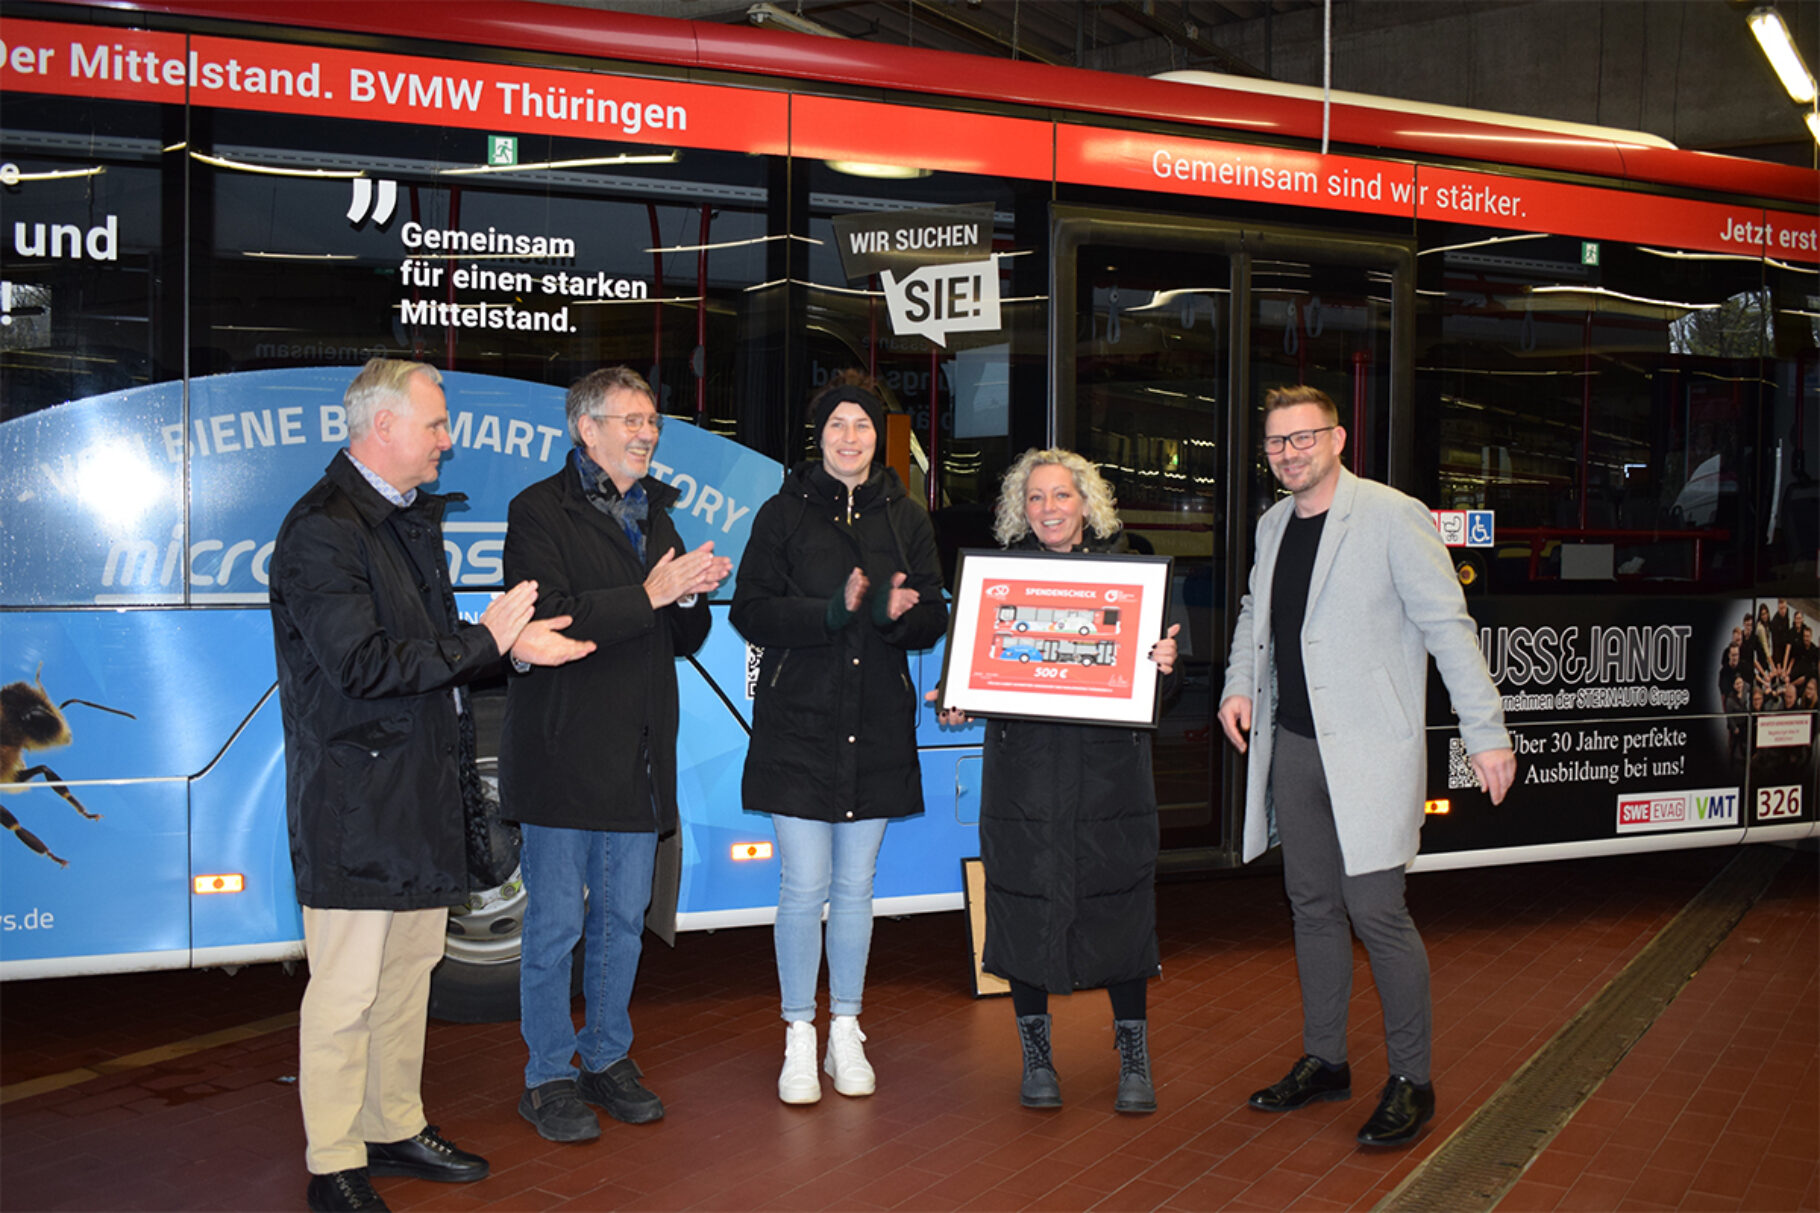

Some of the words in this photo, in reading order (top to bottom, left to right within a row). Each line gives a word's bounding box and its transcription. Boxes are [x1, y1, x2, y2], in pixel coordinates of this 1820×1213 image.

[70, 42, 333, 99] Mittelstand.
[351, 68, 484, 112] BVMW
[496, 82, 687, 134] Thüringen
[1152, 150, 1318, 193] Gemeinsam
[1327, 169, 1381, 201] sind
[1390, 178, 1428, 205] wir
[1436, 184, 1527, 217] stärker.
[15, 215, 117, 261] und
[401, 222, 575, 257] Gemeinsam
[850, 231, 890, 254] WIR
[895, 224, 978, 250] SUCHEN
[1720, 217, 1773, 246] Jetzt
[1779, 229, 1817, 251] erst
[401, 259, 443, 287] für
[452, 264, 532, 293] einen
[541, 272, 647, 299] starken
[905, 275, 981, 322] SIE!
[401, 299, 577, 332] Mittelstand.
[162, 406, 306, 464] BIENE
[1025, 587, 1096, 599] SPENDENSCHECK
[1477, 625, 1692, 686] USS&JANOT
[1034, 667, 1057, 679] 500
[1059, 668, 1068, 679] €
[1556, 688, 1577, 710] der
[1576, 686, 1648, 709] STERNAUTO
[1649, 685, 1690, 710] Gruppe
[1551, 732, 1572, 752] 30
[1576, 730, 1619, 751] Jahre
[1623, 727, 1687, 754] perfekte
[1525, 761, 1619, 784] Ausbildung
[1624, 757, 1647, 777] bei
[1652, 755, 1685, 776] uns!
[1623, 804, 1649, 821] SWE
[1653, 802, 1684, 818] EVAG
[1696, 795, 1736, 819] VMT
[1759, 788, 1799, 817] 326
